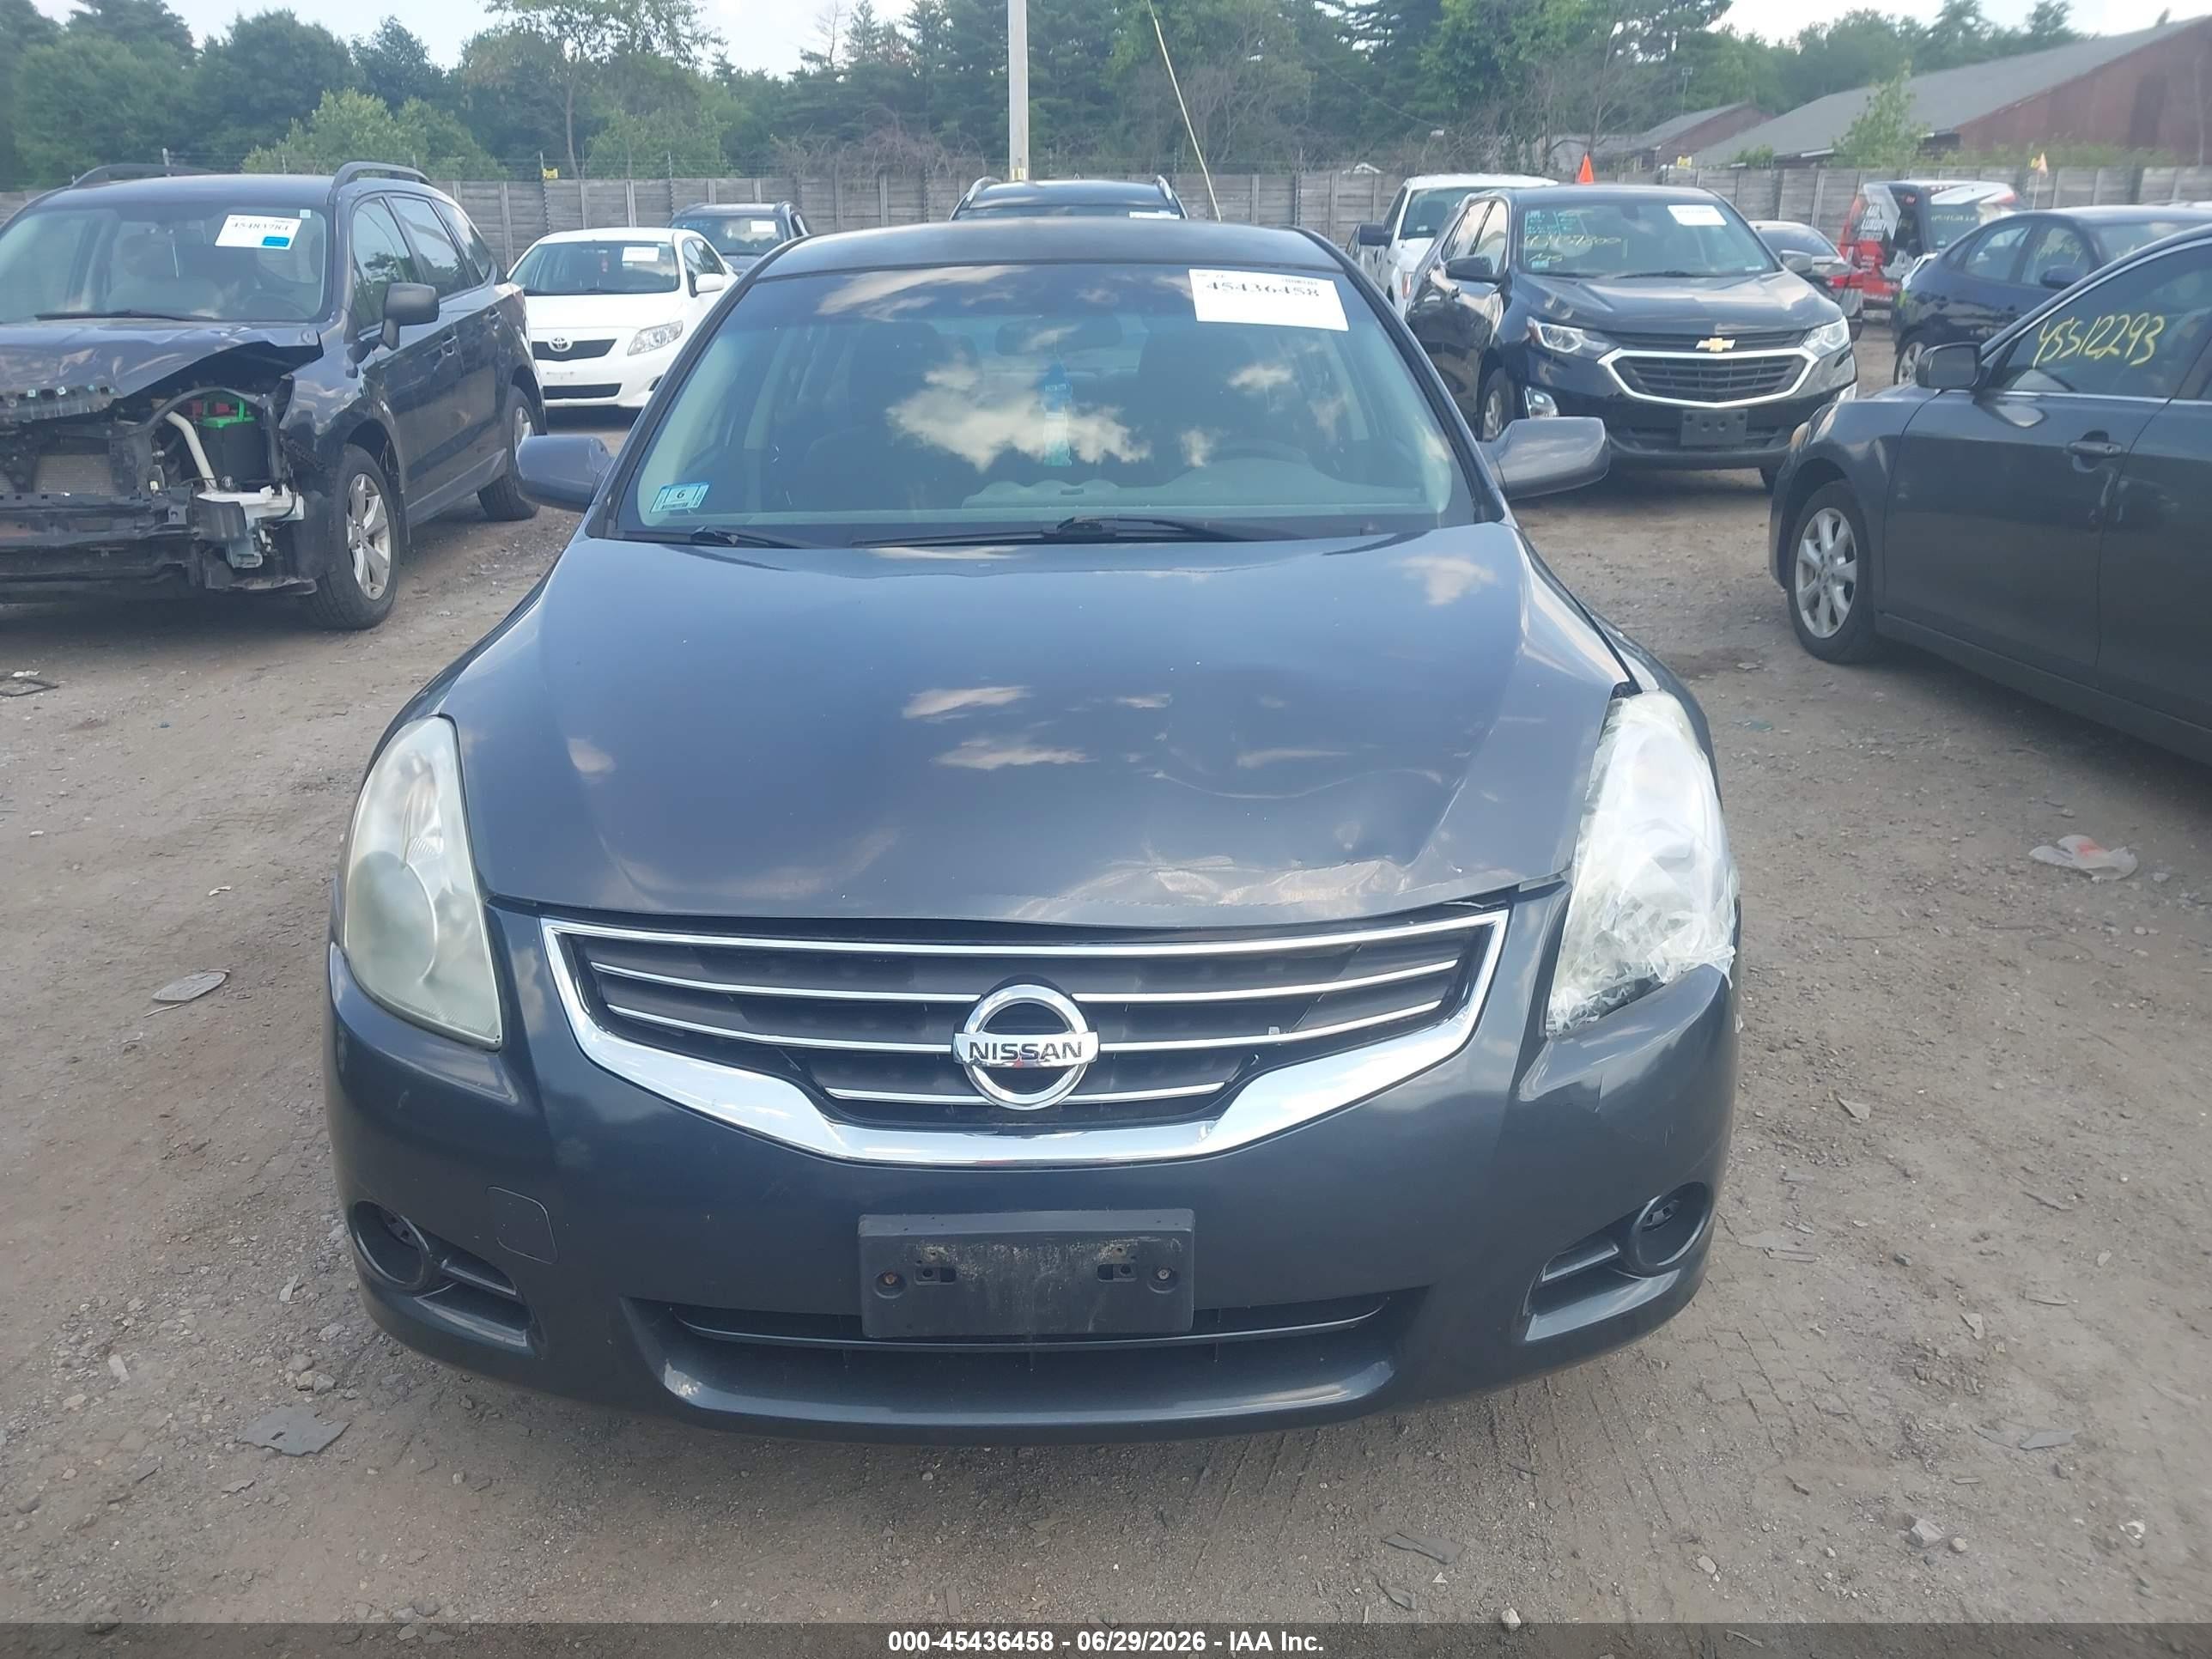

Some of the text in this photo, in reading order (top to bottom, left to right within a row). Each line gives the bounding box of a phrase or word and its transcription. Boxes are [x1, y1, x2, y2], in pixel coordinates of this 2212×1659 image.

[1206, 282, 1320, 297] 45436458
[2033, 312, 2165, 369] 45512293
[969, 1042, 1082, 1060] NISSAN
